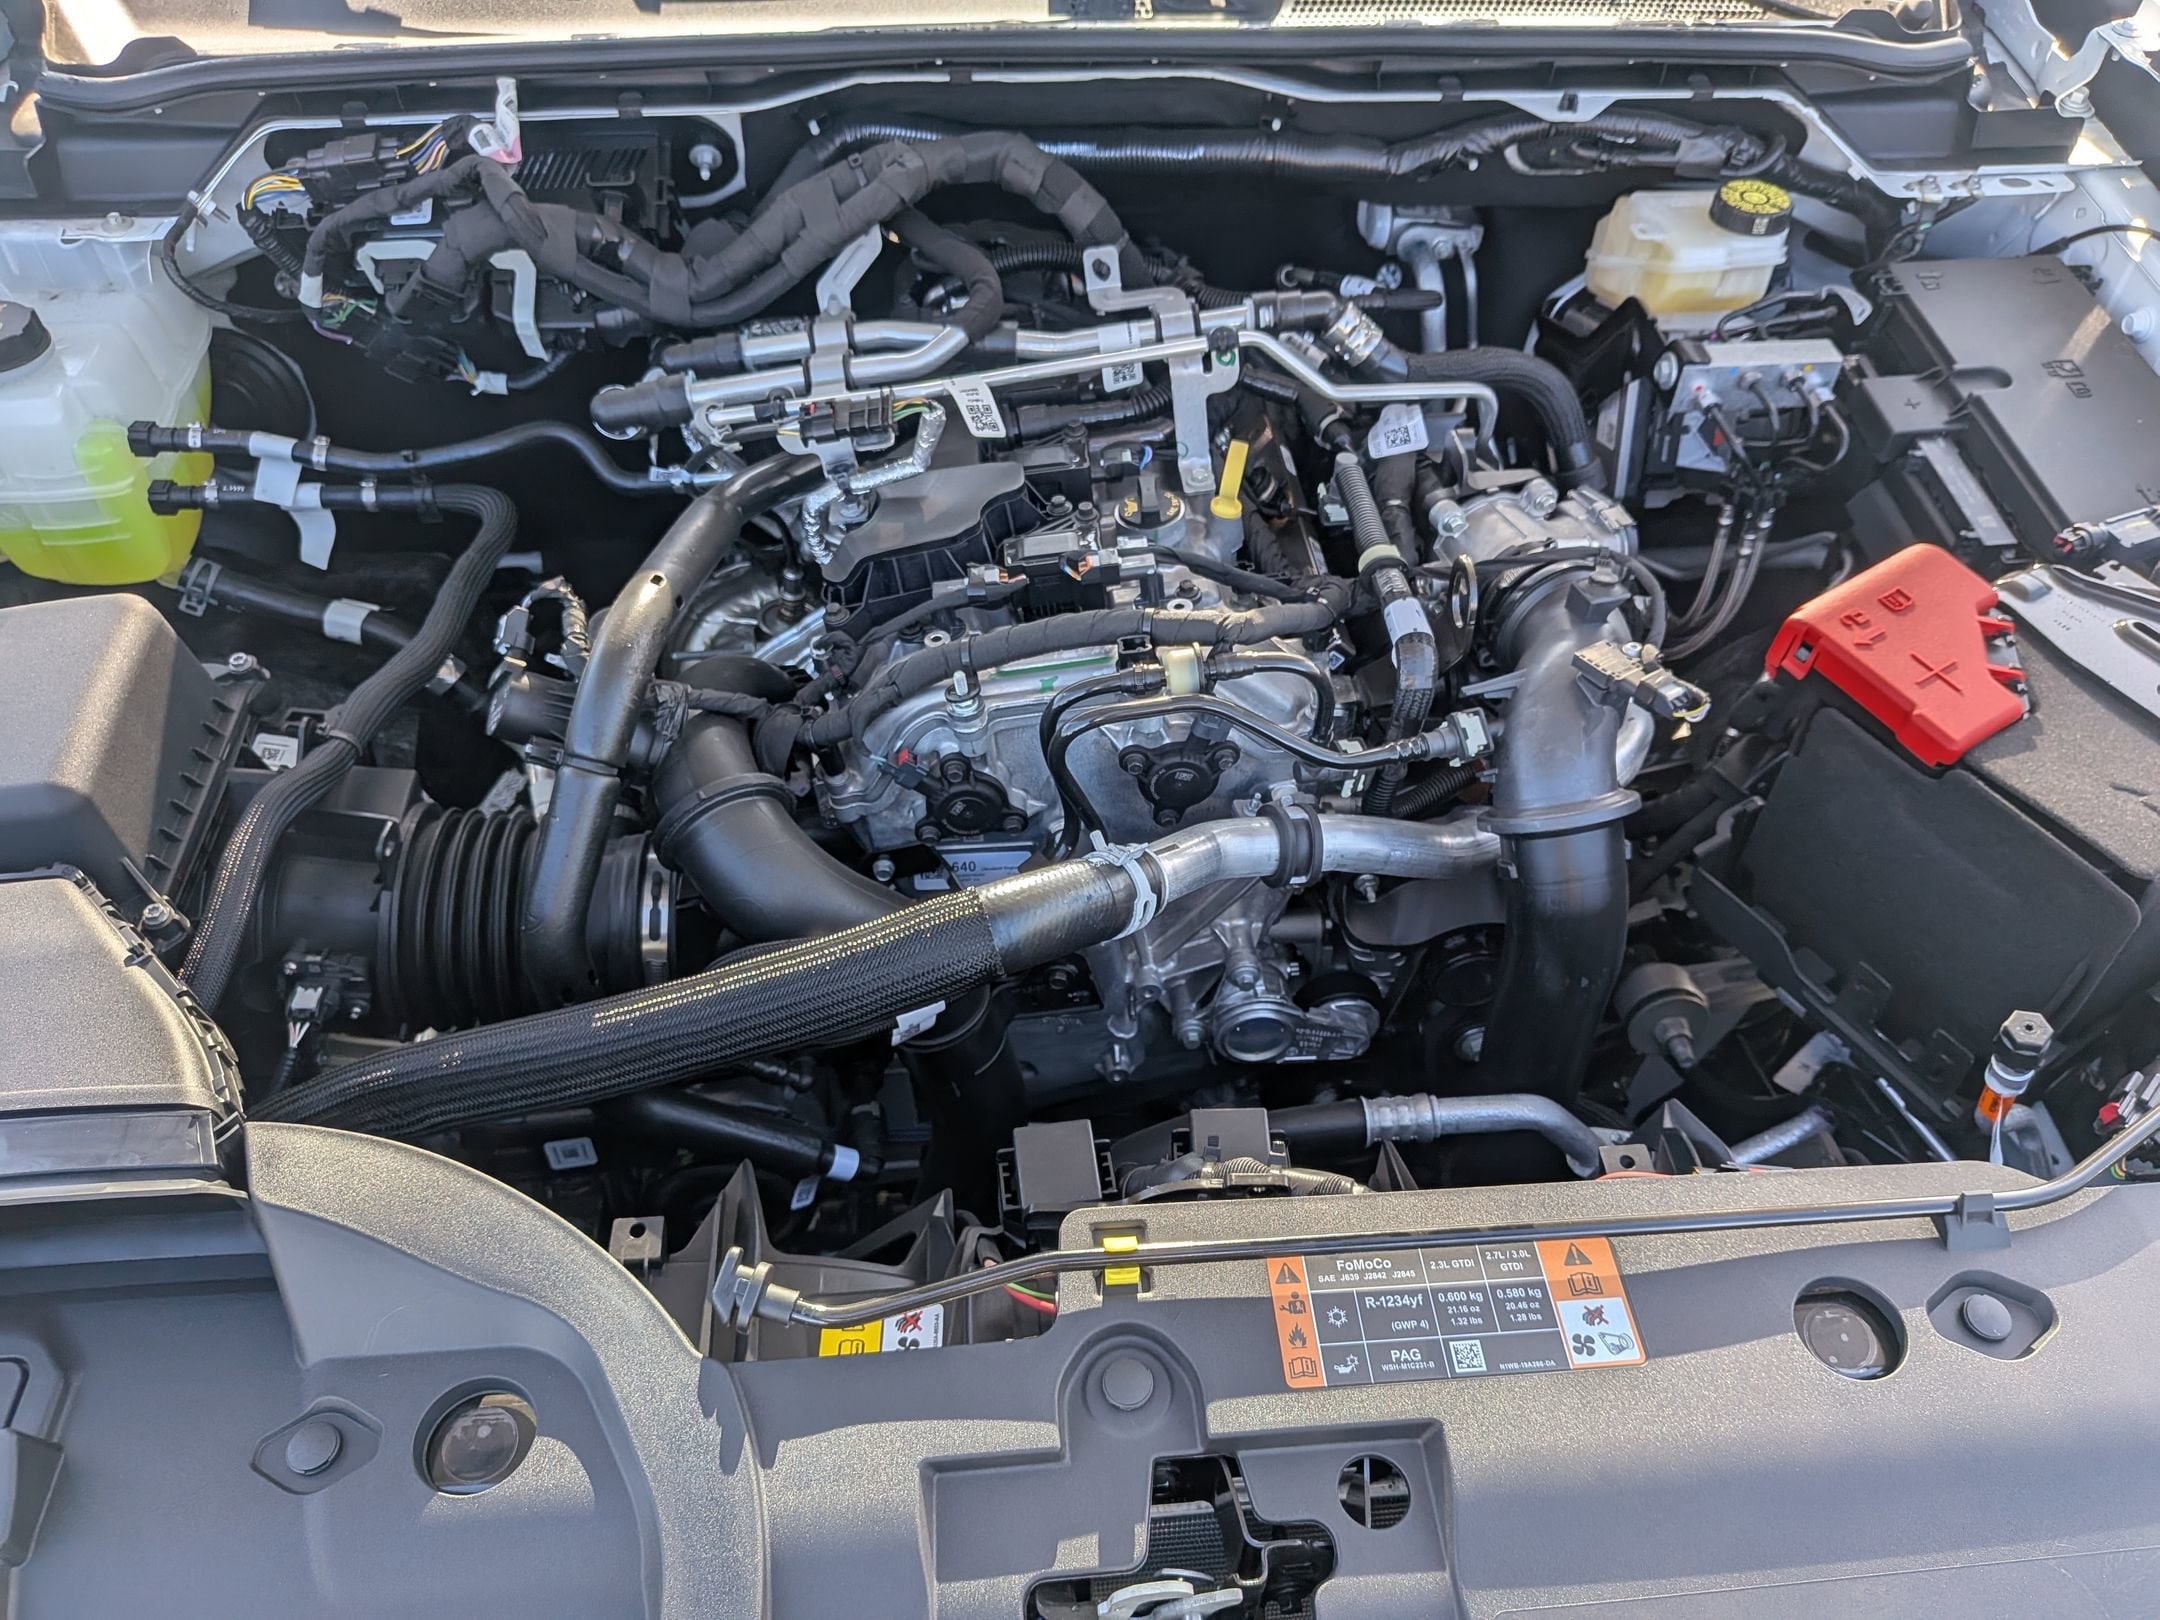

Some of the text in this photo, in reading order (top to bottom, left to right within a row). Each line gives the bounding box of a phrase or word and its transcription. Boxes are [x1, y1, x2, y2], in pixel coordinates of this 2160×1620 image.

[1485, 1250, 1505, 1260] 2.7L
[1511, 1249, 1531, 1258] 3.0L
[1336, 1257, 1392, 1271] FoMoCo
[1429, 1258, 1475, 1270] 2.3L GTDI
[1500, 1262, 1524, 1271] GTDI
[1318, 1274, 1336, 1283] SAE
[1364, 1271, 1387, 1280] J2842
[1392, 1269, 1416, 1279] J2845
[1438, 1290, 1484, 1303] 0.600 kg
[1496, 1287, 1542, 1299] 0.580 kg
[1364, 1293, 1424, 1309] R-1234yf
[1505, 1301, 1540, 1311] 20.46 oz
[1447, 1305, 1481, 1314] 21.16 oz
[1451, 1316, 1483, 1326] 1.32 lbs
[1510, 1312, 1542, 1322] 1.28 lbs
[1391, 1319, 1430, 1332] (GWP 4)
[1390, 1348, 1422, 1362] PAG
